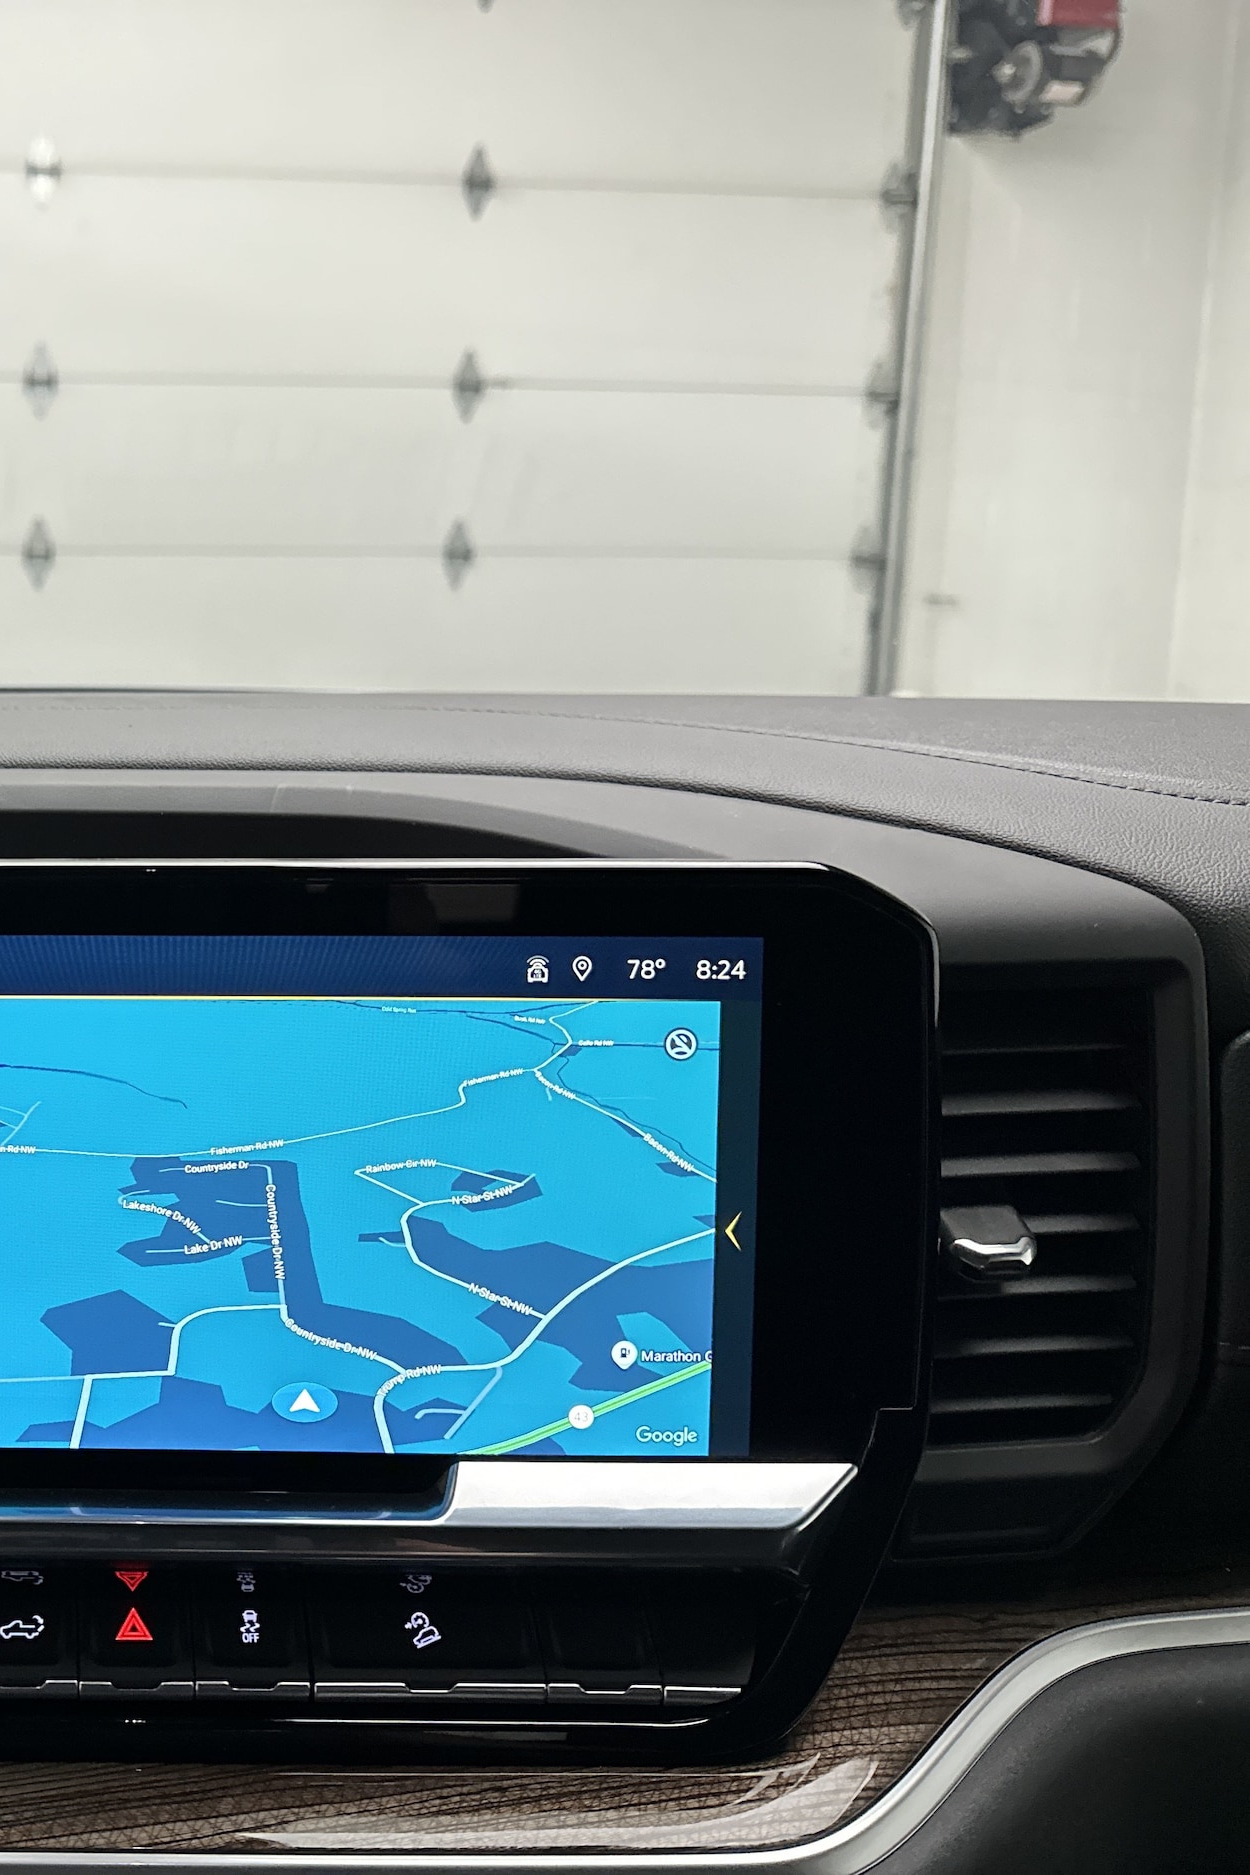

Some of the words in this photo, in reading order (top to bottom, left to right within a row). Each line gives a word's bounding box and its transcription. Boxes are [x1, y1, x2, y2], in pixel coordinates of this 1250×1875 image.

[627, 958, 666, 980] 78°
[695, 959, 747, 980] 8:24
[463, 1073, 501, 1087] Fisherman
[500, 1070, 510, 1078] Rd
[510, 1068, 524, 1077] NW
[535, 1071, 554, 1091] Bacon
[553, 1085, 564, 1096] Rd
[562, 1089, 576, 1100] NW
[7, 1145, 19, 1153] Rd
[21, 1146, 36, 1154] NW
[210, 1145, 255, 1155] Fisherman
[255, 1142, 268, 1150] Rd
[269, 1139, 284, 1148] NW
[643, 1133, 669, 1154] Bacon
[666, 1150, 679, 1162] Rd
[677, 1156, 694, 1172] NW
[184, 1161, 238, 1174] Countryside
[238, 1160, 249, 1169] Dr
[365, 1162, 404, 1174] Rainbow
[420, 1158, 437, 1167] NW
[451, 1196, 460, 1205] N
[461, 1193, 481, 1204] Star
[482, 1190, 494, 1201] St
[494, 1185, 513, 1198] NW
[122, 1200, 172, 1217] Lakeshore
[172, 1211, 184, 1222] Dr
[183, 1218, 201, 1234] NW
[266, 1184, 281, 1245] Countryside
[184, 1242, 209, 1254] Lake
[209, 1240, 223, 1251] Dr
[223, 1235, 243, 1247] NW
[272, 1246, 283, 1258] Dr
[274, 1260, 286, 1280] NW
[468, 1282, 479, 1293] N
[479, 1287, 501, 1303] Star
[500, 1295, 513, 1307] St
[511, 1300, 533, 1316] NW
[285, 1319, 342, 1351] Countryside
[343, 1342, 356, 1353] Dr
[356, 1346, 377, 1361] NW
[641, 1350, 702, 1363] Marathon
[406, 1368, 421, 1379] Rd
[422, 1364, 442, 1375] NW
[573, 1411, 589, 1423] 43
[636, 1426, 698, 1447] Google
[242, 1633, 260, 1643] OFF
